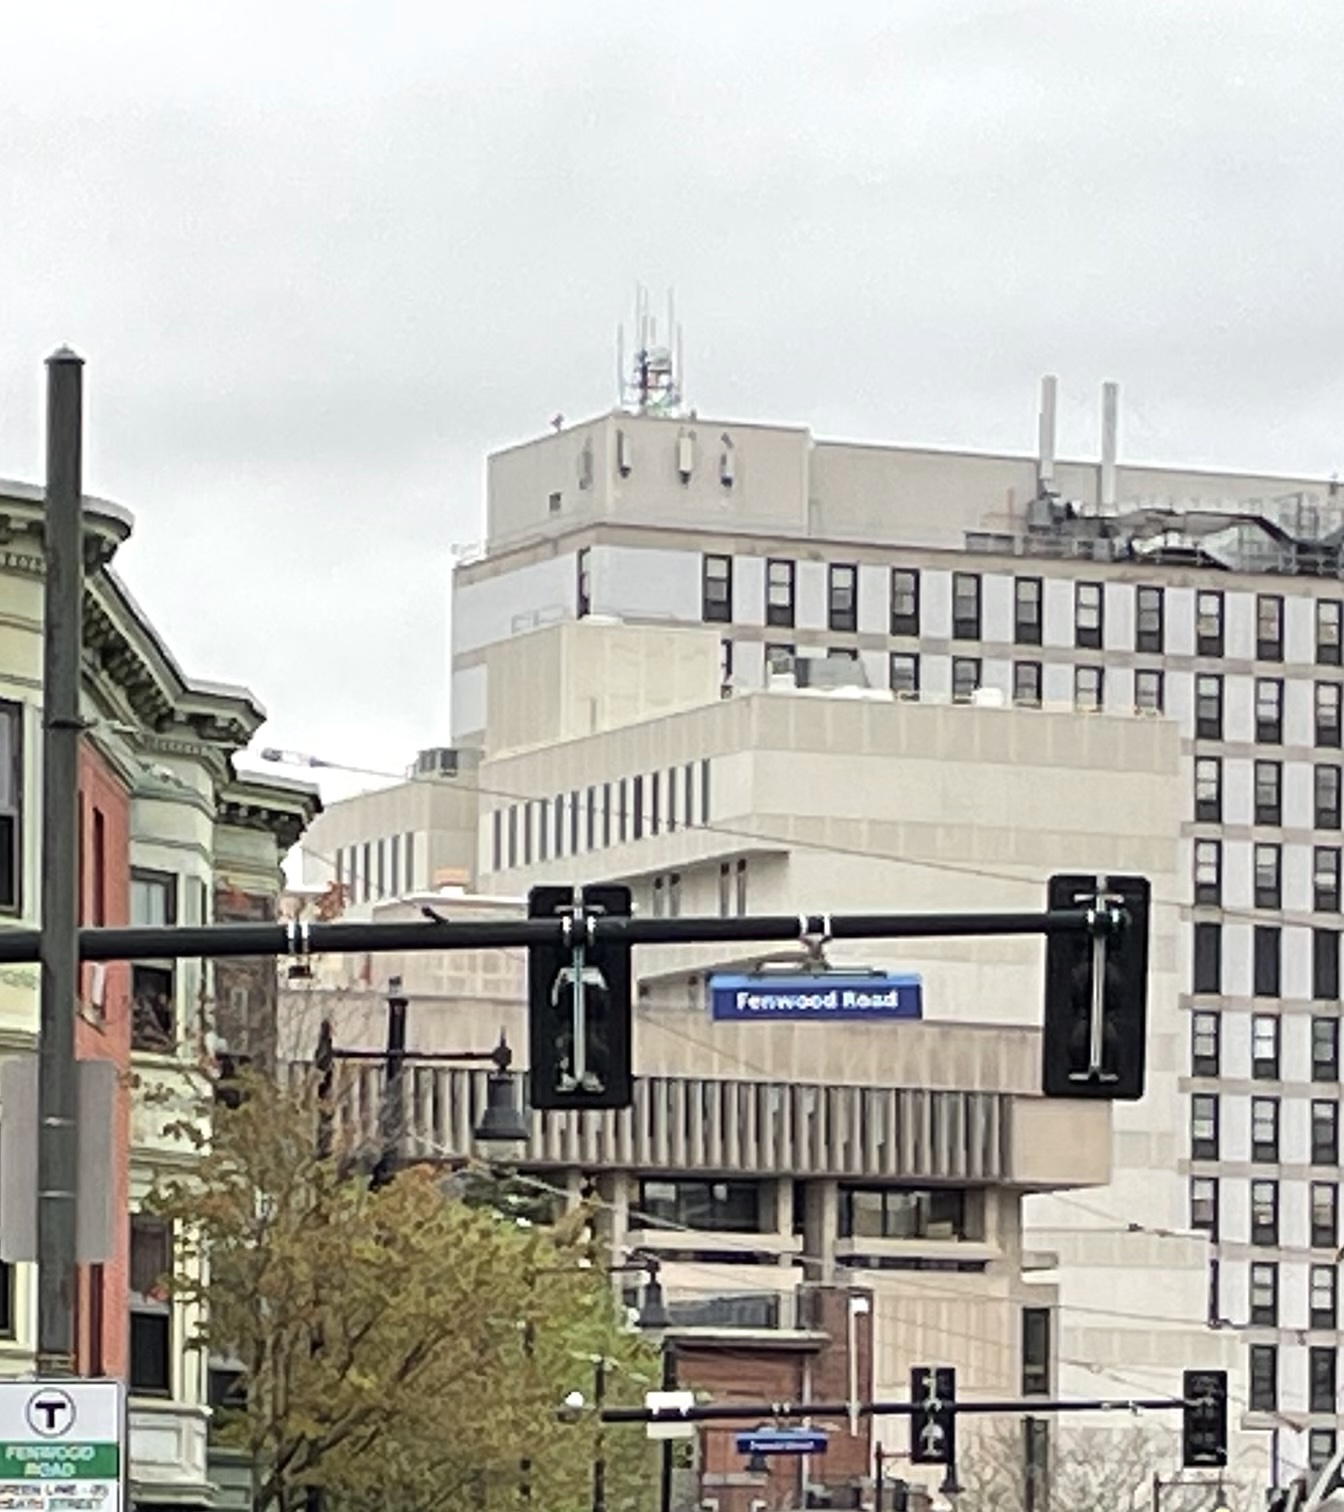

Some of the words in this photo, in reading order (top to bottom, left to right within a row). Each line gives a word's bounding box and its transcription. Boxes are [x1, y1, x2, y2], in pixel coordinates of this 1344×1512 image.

[736, 991, 838, 1010] Fenwood
[842, 990, 899, 1009] Road
[5, 1446, 96, 1461] FENWOOD
[24, 1462, 77, 1478] ROAD
